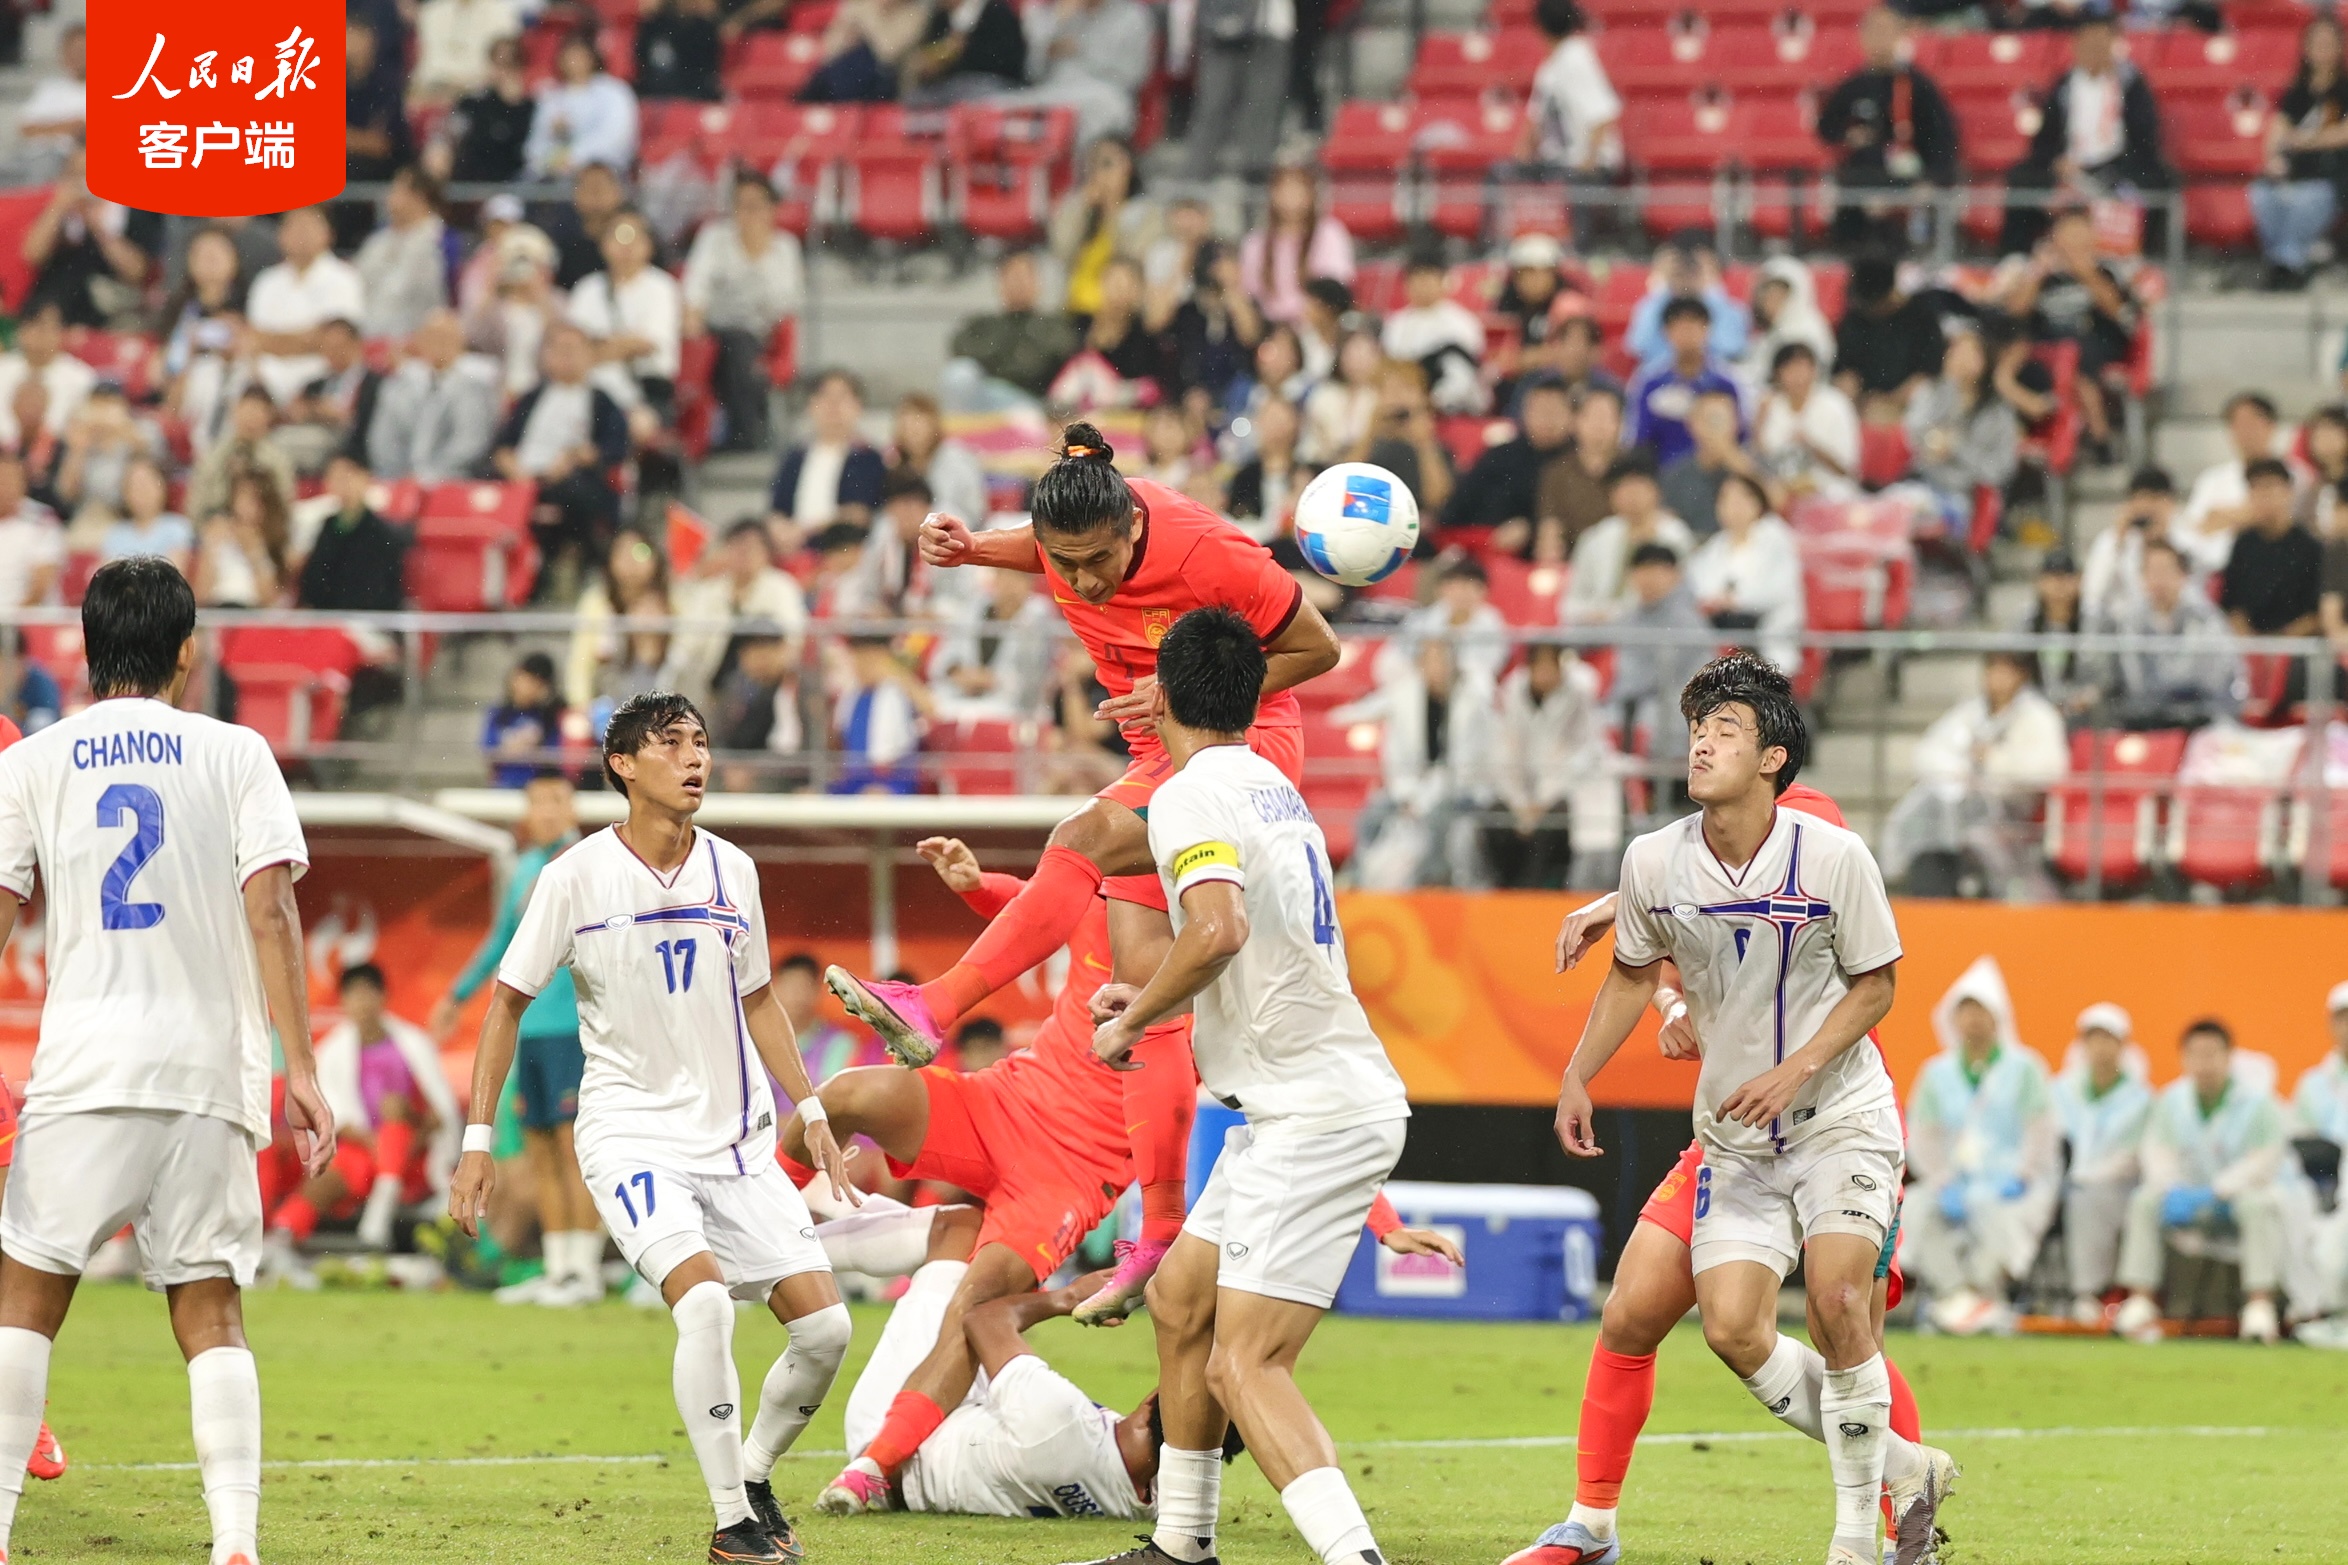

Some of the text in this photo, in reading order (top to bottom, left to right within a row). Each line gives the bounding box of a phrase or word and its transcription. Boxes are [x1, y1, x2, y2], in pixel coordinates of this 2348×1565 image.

[73, 730, 182, 770] CHANON
[96, 784, 165, 930] 2
[1175, 849, 1215, 878] ptain
[1303, 840, 1335, 945] 4
[654, 937, 697, 995] 17
[614, 1170, 656, 1229] 17
[1695, 1166, 1712, 1220] 6
